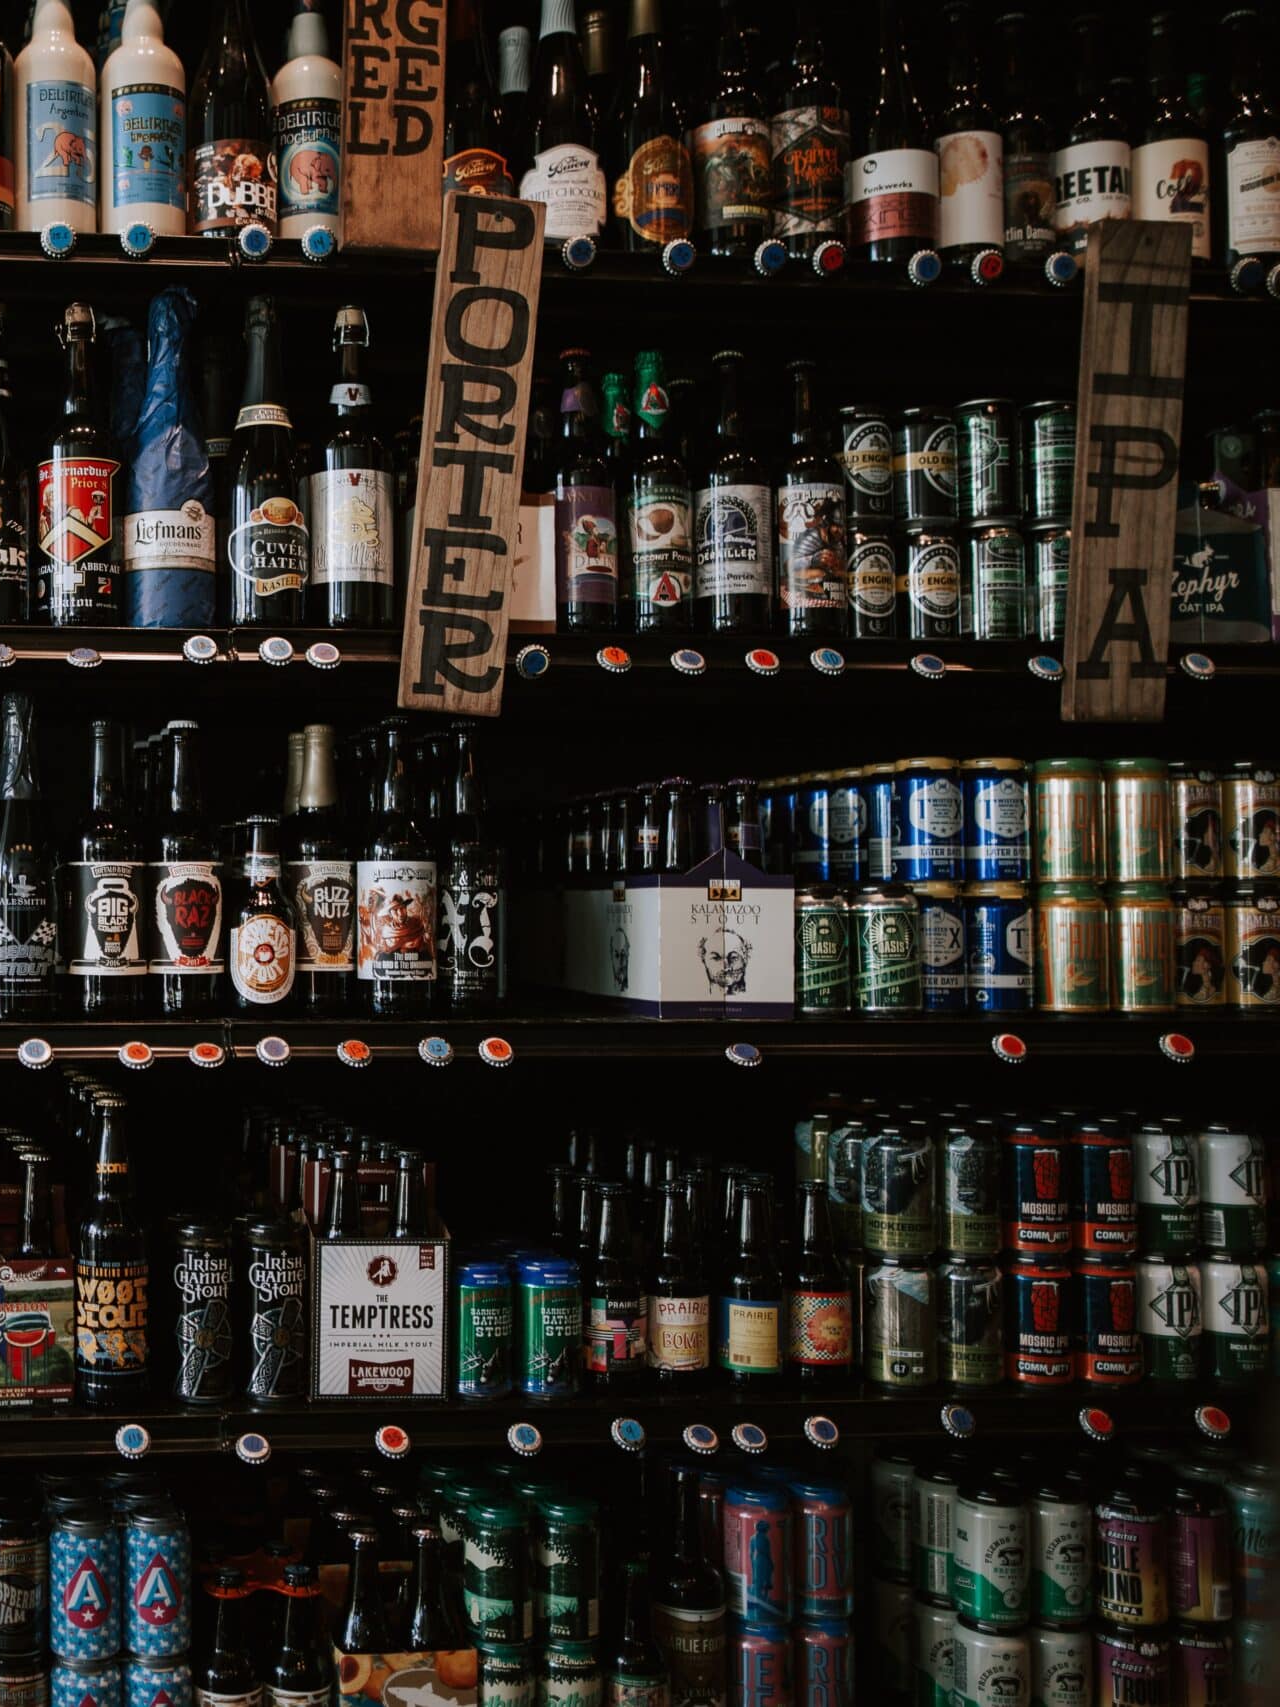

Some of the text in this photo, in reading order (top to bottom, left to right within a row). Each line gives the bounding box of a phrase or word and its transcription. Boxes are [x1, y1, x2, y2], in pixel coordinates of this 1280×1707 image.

[411, 194, 535, 697] PORTER
[918, 454, 939, 465] OLD
[70, 476, 98, 489] Prior
[134, 518, 203, 545] Liefmans
[80, 561, 121, 574] ABBEY ALE
[1178, 602, 1225, 613] OAT IPA
[314, 887, 350, 904] BUZZ
[97, 897, 129, 917] BIG
[313, 902, 350, 920] NUTZ
[691, 903, 762, 915] KALAMAZOO
[98, 915, 128, 926] BLACK
[174, 906, 210, 929] RAZ
[690, 914, 762, 926] STOUT
[809, 942, 838, 955] OASIS
[878, 941, 906, 954] OASIS
[938, 976, 959, 986] DAYS
[1162, 1159, 1200, 1197] IPA
[1021, 1201, 1057, 1216] MOSAIC
[1096, 1201, 1133, 1216] MOSAIC
[375, 1294, 389, 1303] THE
[76, 1303, 149, 1330] STOUT
[329, 1304, 435, 1330] TEMPTRESS
[732, 1309, 774, 1321] PRAIRIE
[1165, 1290, 1200, 1329] IPA
[1232, 1290, 1269, 1329] IPA
[329, 1341, 434, 1349] IMPERIAL MILK STOUT
[1021, 1333, 1056, 1348] MOSAIC
[1097, 1333, 1133, 1347] MOSAIC
[351, 1365, 412, 1379] LAKEWOOD
[67, 1569, 108, 1611] A
[137, 1566, 178, 1607] A
